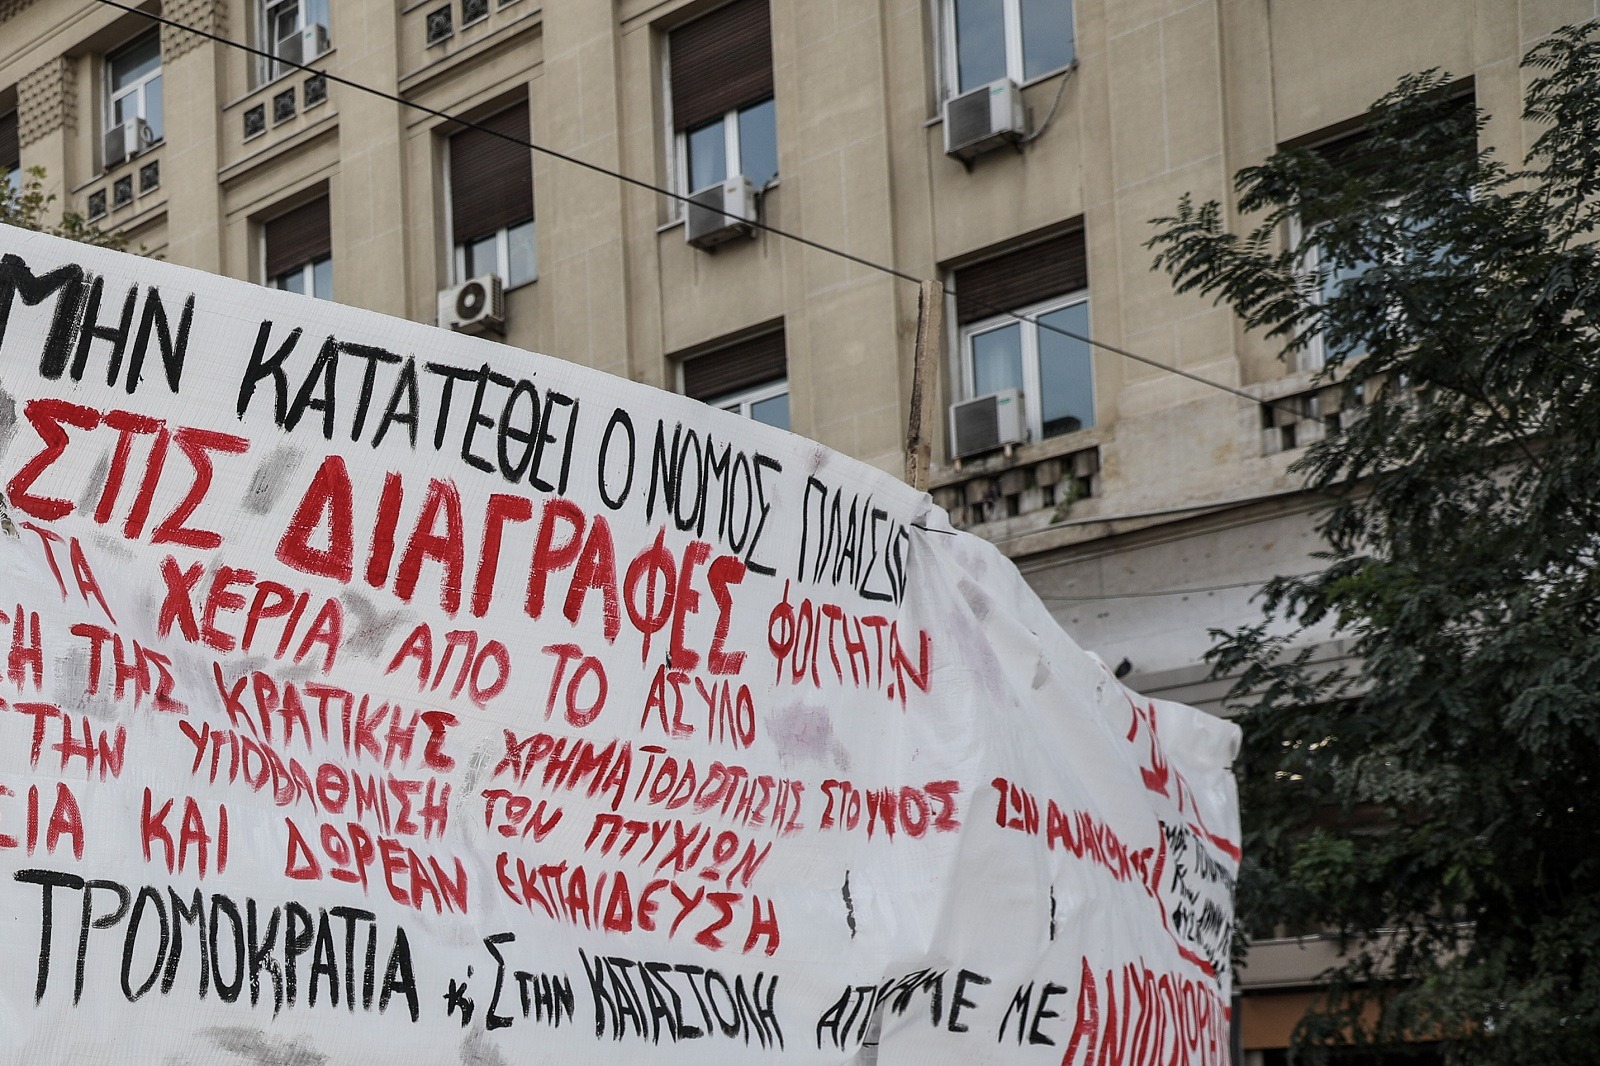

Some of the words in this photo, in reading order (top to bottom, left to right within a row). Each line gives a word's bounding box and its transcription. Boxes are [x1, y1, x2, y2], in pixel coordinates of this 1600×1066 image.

[5, 399, 250, 549] ΣΤΙΣ
[275, 455, 747, 675] ΔΙΑΓΡΑΦΕΣ
[236, 319, 579, 496] ΚΑΤΑΤΕΘΕΙ
[598, 407, 635, 510] Ο
[646, 419, 783, 576] ΝΟΜΟΣ
[19, 521, 118, 627] ΤΑ
[158, 555, 344, 676] ΧΕΡΙΑ
[385, 621, 511, 711] ΑΠΟ
[541, 643, 609, 728] ΤΟ
[640, 664, 756, 751] ΑΣΥΛΟ
[69, 623, 189, 715] ΤΗΣ
[213, 660, 461, 772] ΚΡΑΤΙΚΗΣ
[140, 786, 228, 880] ΚΑΙ
[284, 816, 468, 914] ΔΩΡΕΑΝ
[496, 851, 780, 956] ΕΚΠΑΙΔΕΥΣΗ
[179, 719, 452, 839] ΥΠΟΒΑΘΜΙΣΗ
[480, 788, 564, 842] ΤΩΝ
[584, 813, 772, 890] ΠΤΥΧΙΩΝ
[13, 869, 420, 1024] ΤΡΟΜΟΚΡΑΤΙΑ
[578, 946, 785, 1052] ΚΑΤΑΣΤΟΛΗ
[998, 980, 1068, 1047] ΜΕ
